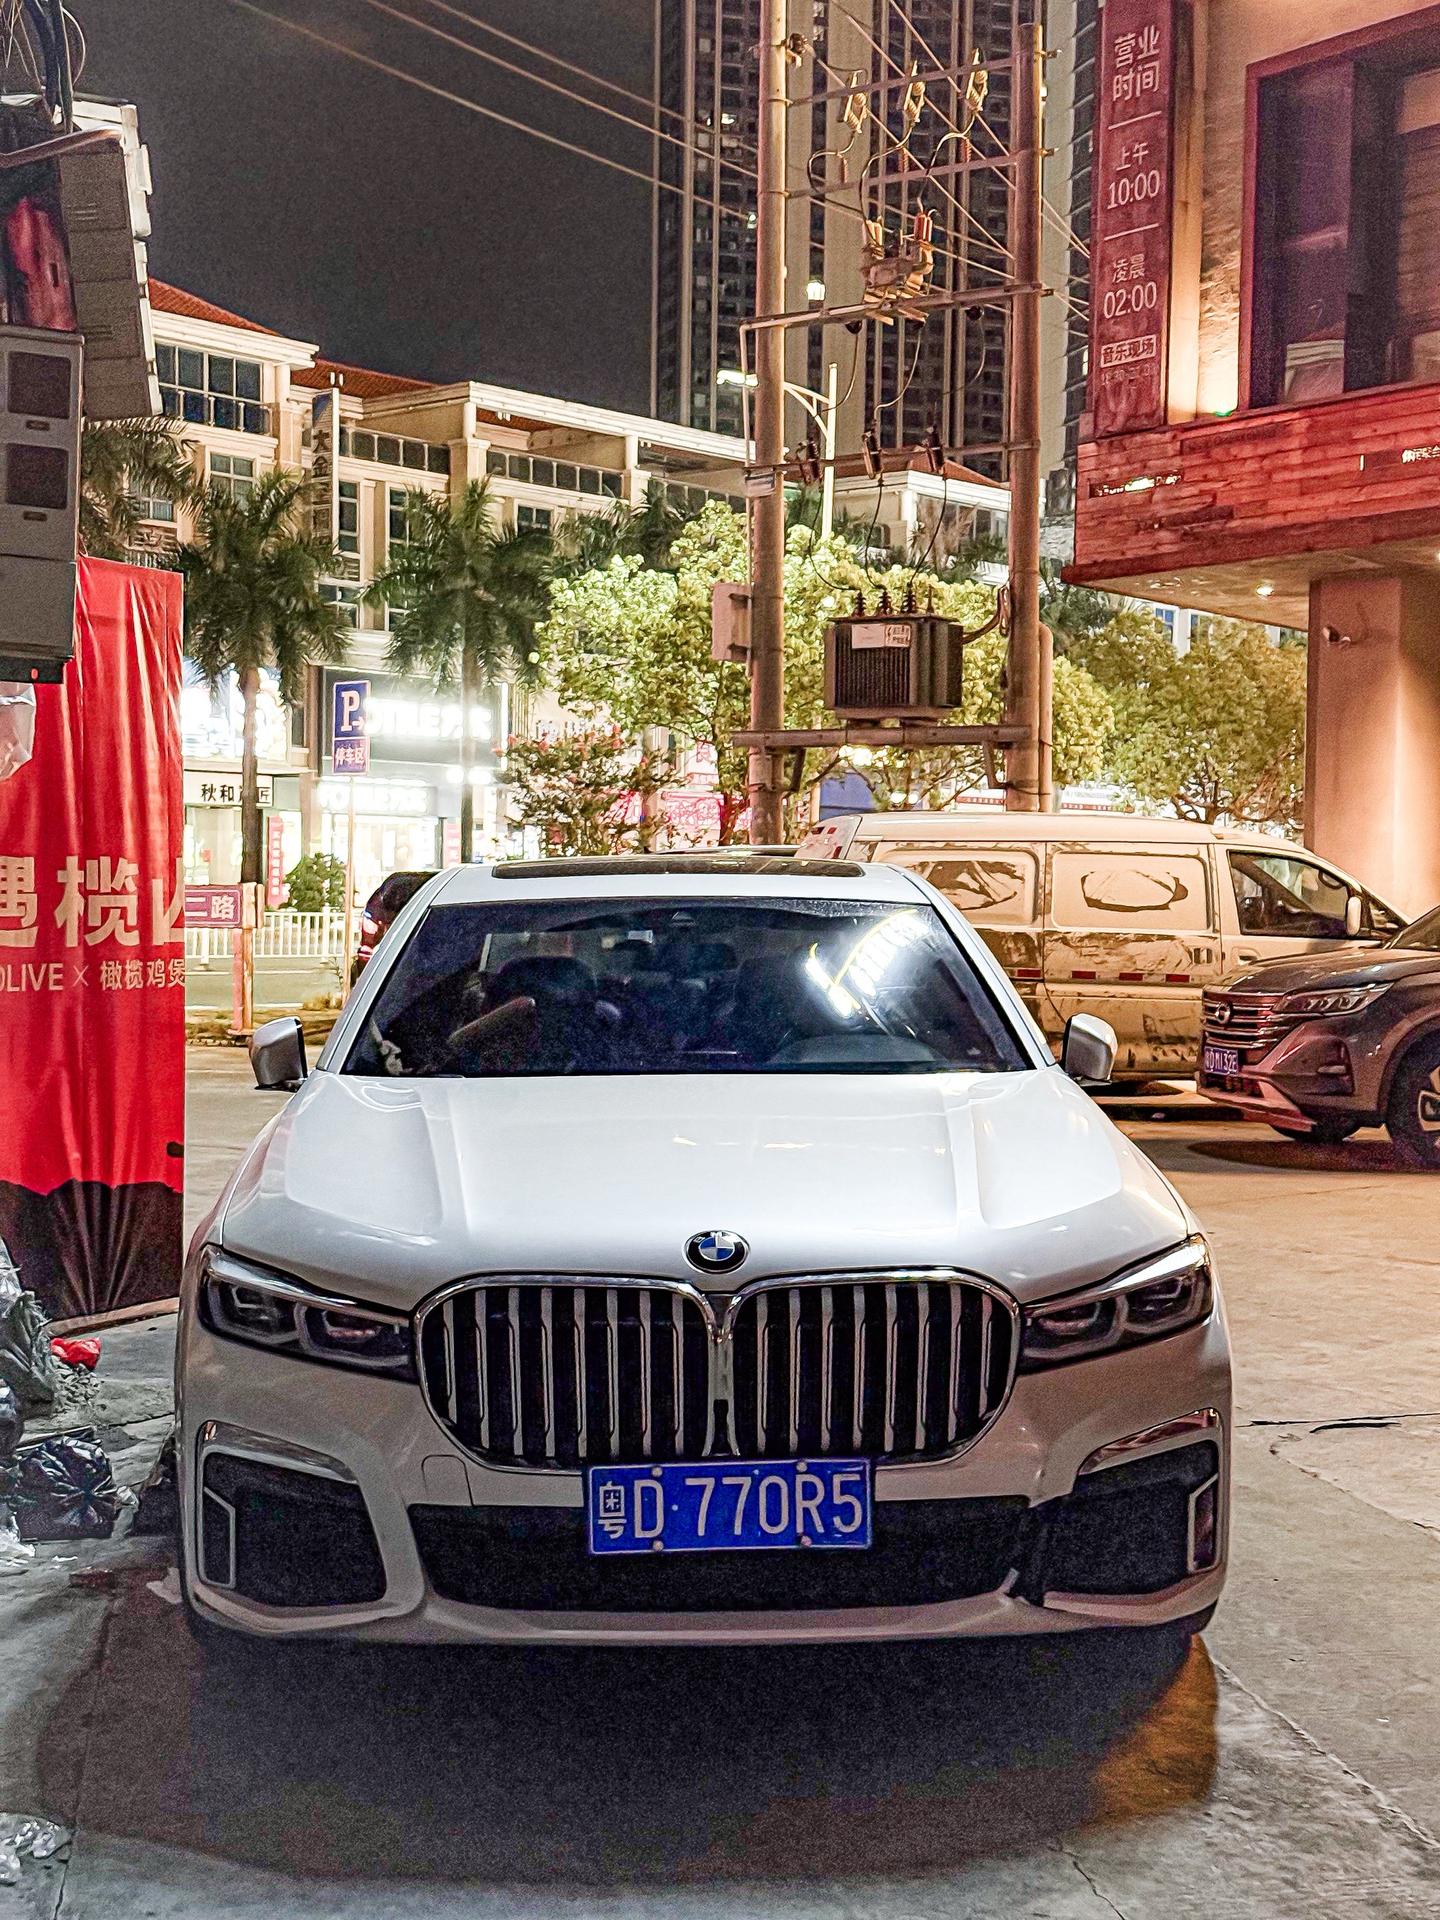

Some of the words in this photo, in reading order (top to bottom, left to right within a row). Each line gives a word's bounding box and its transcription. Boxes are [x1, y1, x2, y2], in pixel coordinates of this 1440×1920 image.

[1113, 24, 1160, 69] 营业
[1112, 60, 1160, 102] 时间
[1115, 142, 1149, 171] 上午
[1107, 169, 1160, 209] 10:00
[1112, 253, 1145, 283] 凌晨
[1103, 281, 1157, 319] 02:00
[341, 689, 360, 732] P
[335, 744, 365, 767] 停车区
[201, 783, 271, 803] 秋和匠
[100, 958, 185, 991] 橄榄鸡煲
